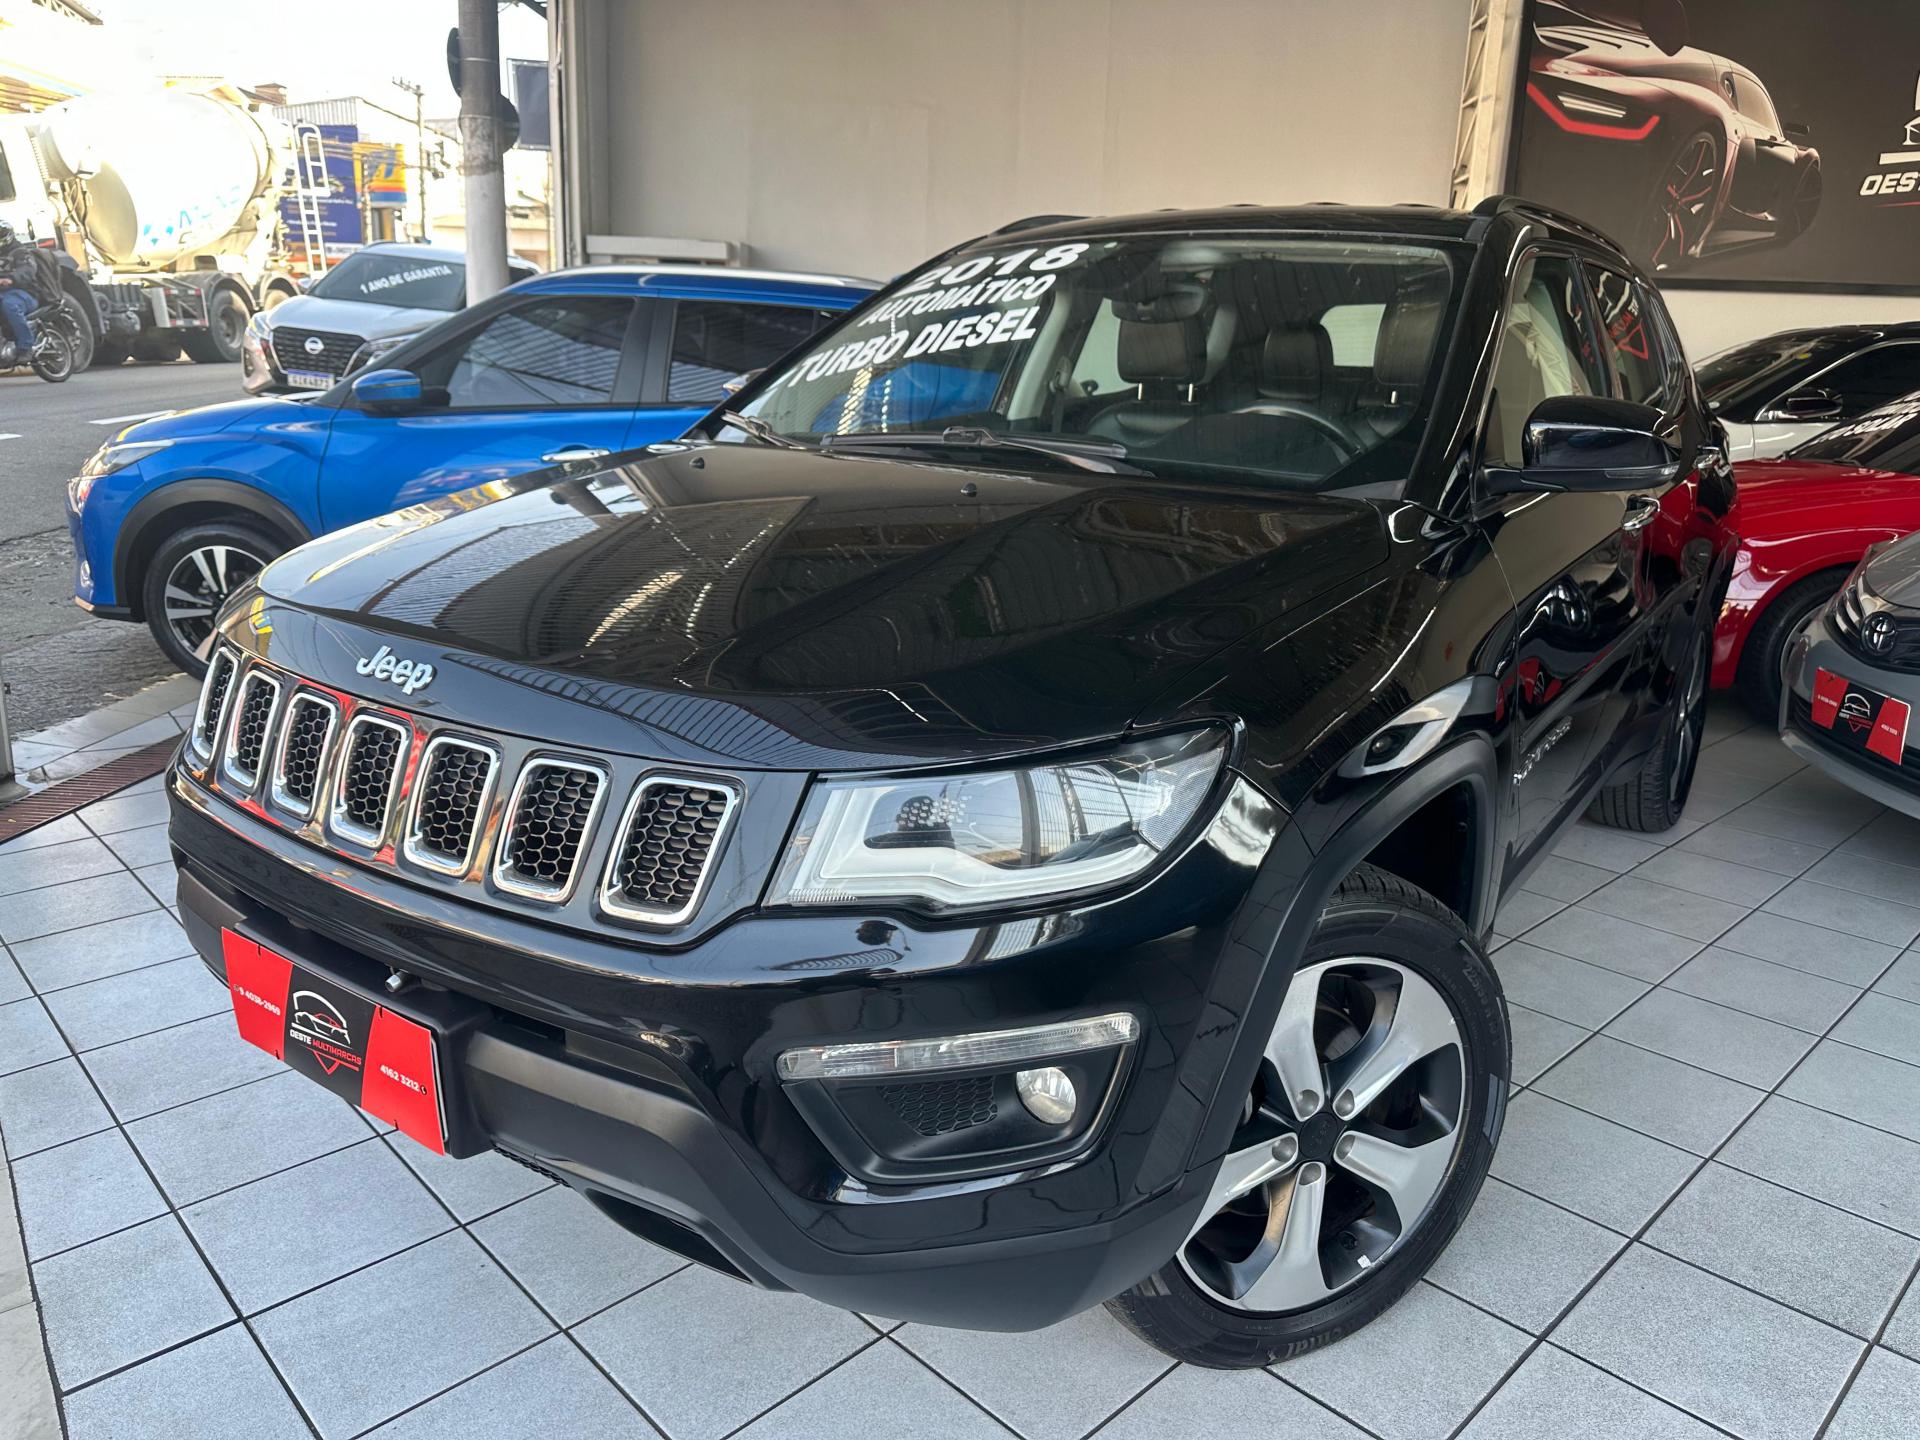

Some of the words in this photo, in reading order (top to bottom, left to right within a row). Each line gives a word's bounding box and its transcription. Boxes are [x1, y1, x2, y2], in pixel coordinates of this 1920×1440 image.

[1859, 171, 1920, 196] OES
[360, 283, 369, 295] 1
[388, 273, 404, 286] DE
[403, 265, 452, 282] GARANTIA
[892, 243, 1090, 298] 2018
[857, 273, 1057, 328] AUTOMÁTICO
[788, 329, 909, 388] TURBO
[903, 305, 1041, 359] DIESEL
[355, 645, 434, 696] Jeep
[289, 1028, 312, 1045] OESTE
[312, 1038, 362, 1065] MULTIMARCAS
